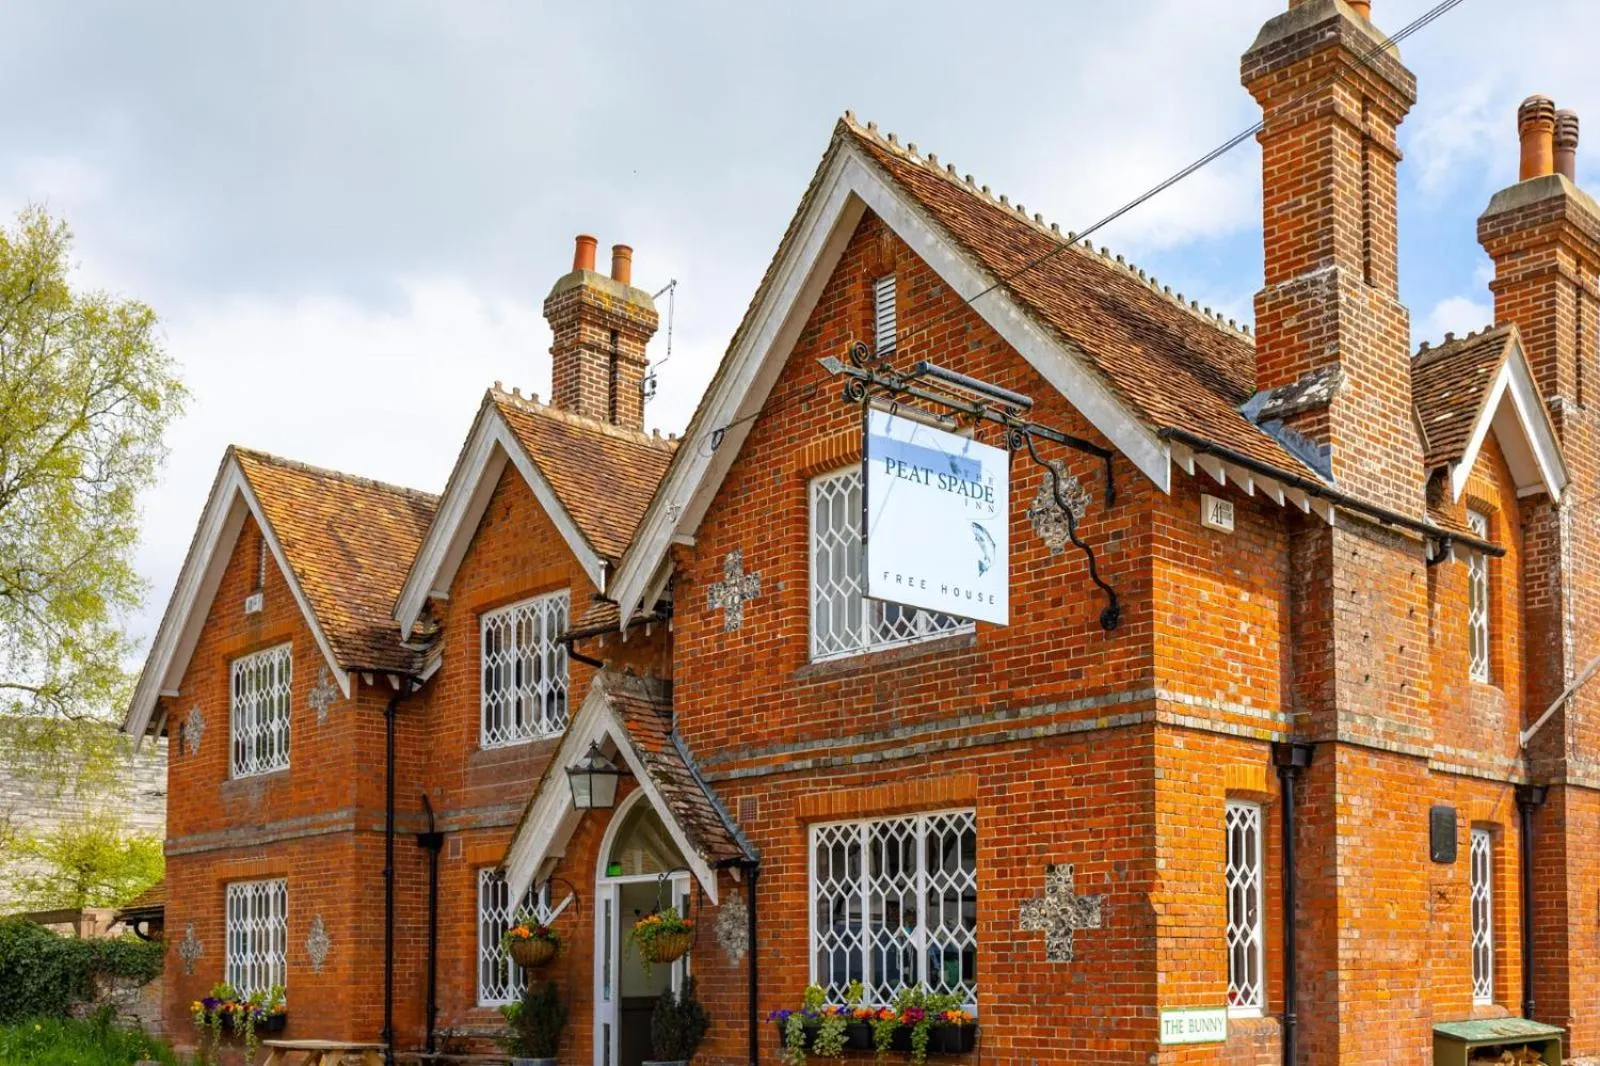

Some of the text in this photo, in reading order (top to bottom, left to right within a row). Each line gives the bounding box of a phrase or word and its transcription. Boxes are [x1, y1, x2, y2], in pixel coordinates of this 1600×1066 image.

[885, 456, 995, 504] PEAT SPADE
[964, 498, 994, 513] INN
[883, 571, 995, 605] FREE HOUSE
[1164, 1016, 1224, 1035] THE BUNNY
